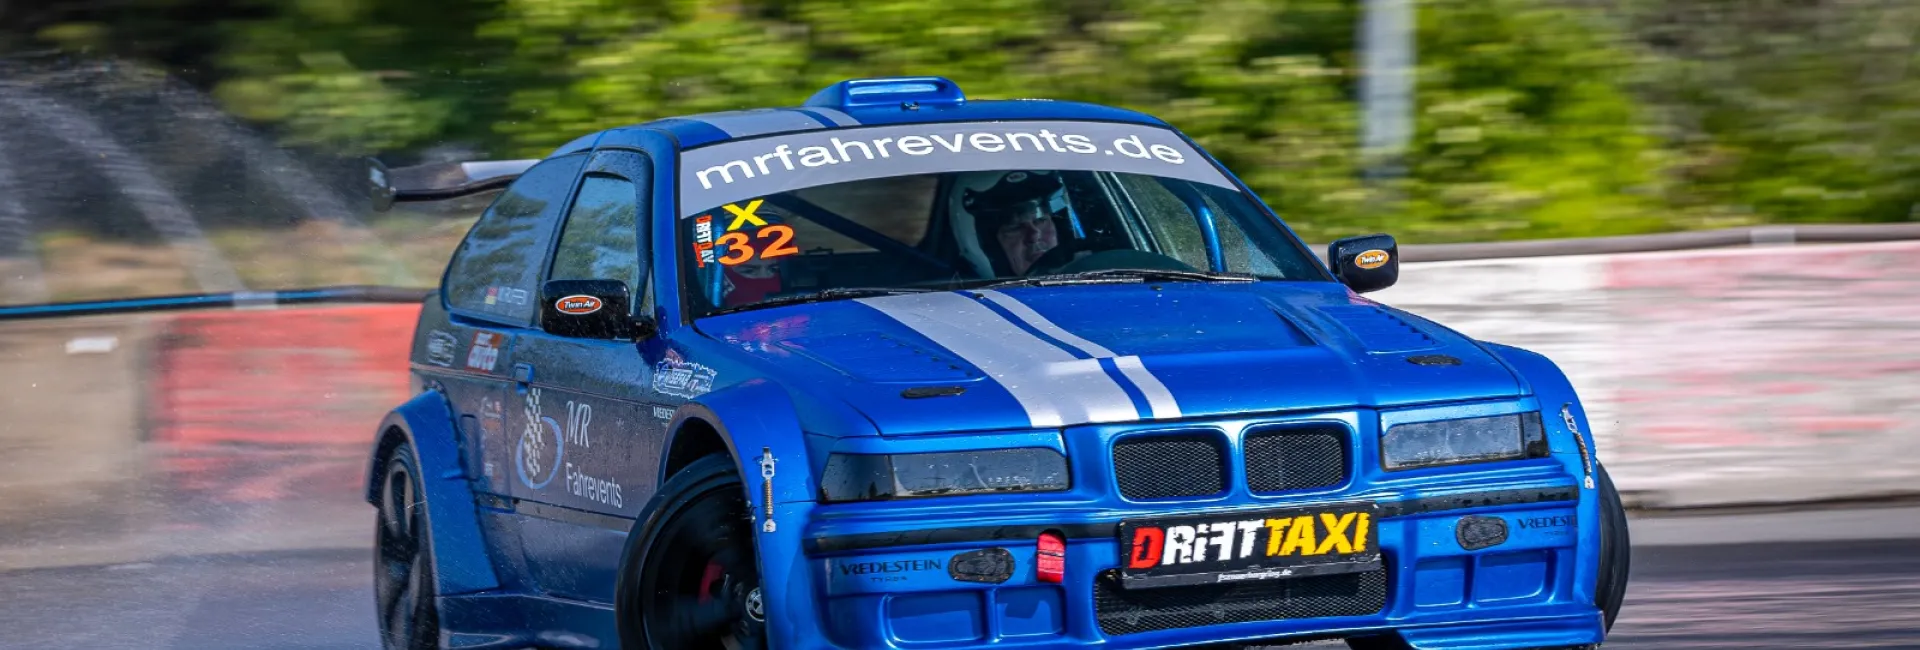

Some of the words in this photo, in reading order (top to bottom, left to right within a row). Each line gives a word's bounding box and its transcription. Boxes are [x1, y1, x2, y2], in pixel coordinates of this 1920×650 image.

[696, 128, 1185, 190] mrfahrevents.de
[722, 200, 768, 231] X
[715, 225, 799, 266] 32
[563, 301, 583, 309] Twin
[583, 300, 595, 308] Air
[565, 401, 592, 448] MR
[565, 462, 623, 509] Fahrevents
[840, 559, 942, 576] VREDESTEIN
